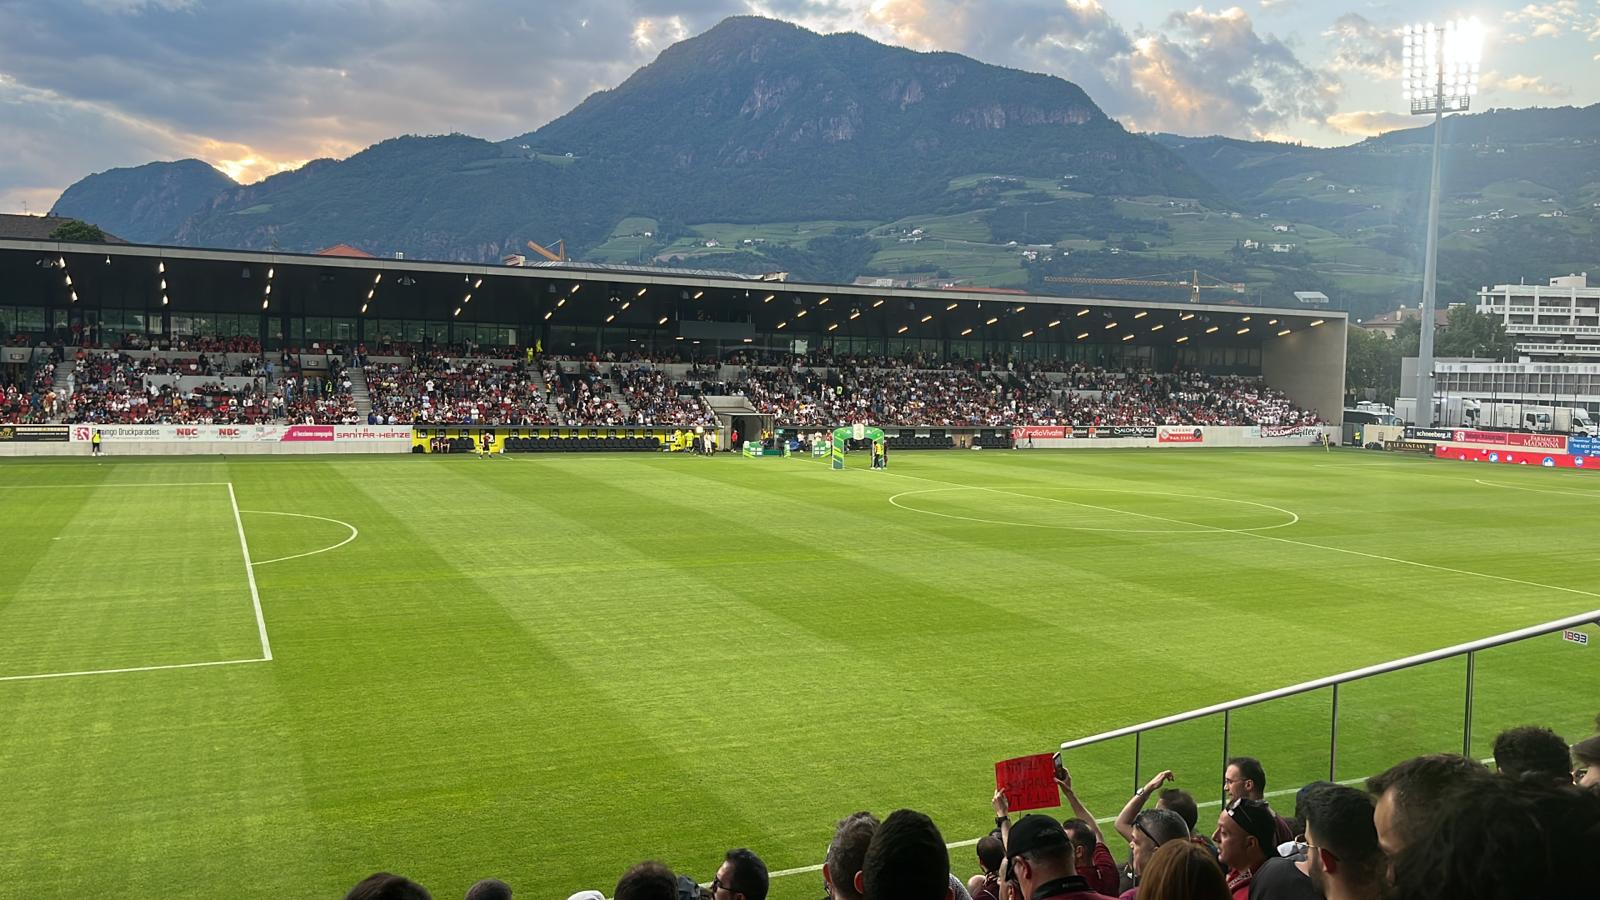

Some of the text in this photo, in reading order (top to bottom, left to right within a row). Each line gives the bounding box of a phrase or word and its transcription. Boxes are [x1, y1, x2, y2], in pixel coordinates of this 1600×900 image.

[176, 428, 198, 436] NBC
[218, 428, 240, 436] NBC
[1417, 431, 1452, 439] schneeberg.it
[1530, 435, 1559, 443] FARMACIA
[1524, 440, 1559, 448] MADONNA
[1565, 631, 1587, 643] 1893
